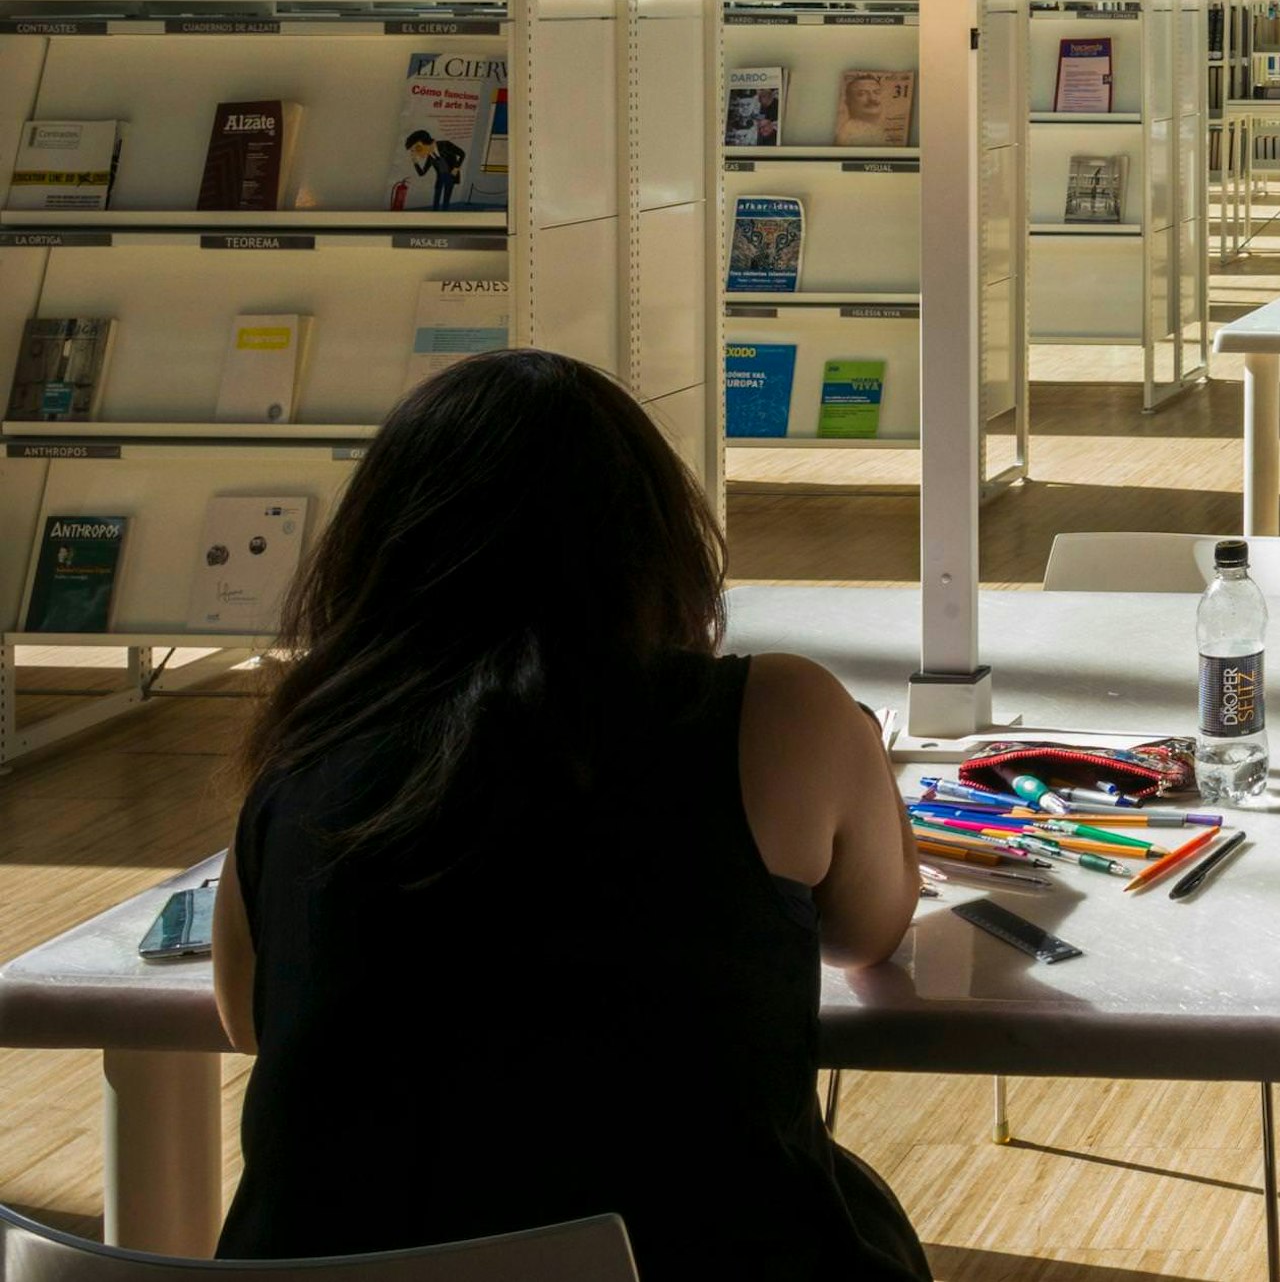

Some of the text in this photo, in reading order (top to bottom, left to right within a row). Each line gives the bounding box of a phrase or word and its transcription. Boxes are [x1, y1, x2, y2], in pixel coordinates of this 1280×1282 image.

[16, 23, 78, 34] CONTRASTES
[182, 22, 280, 33] CUADERNOS DE ALZATE
[401, 23, 458, 33] EL CIERVO
[416, 58, 440, 77] EL
[730, 73, 768, 82] DARDO
[411, 84, 442, 98] Cómo
[432, 99, 442, 109] el
[444, 101, 462, 110] arte
[223, 114, 276, 131] Alzate
[864, 164, 893, 172] VISUAL
[15, 236, 63, 245] LA ORTIGA
[225, 237, 280, 248] TEOREMA
[409, 237, 449, 248] PASAJES
[440, 281, 510, 292] PASAJES
[24, 447, 88, 458] ANTHROPOS
[50, 521, 121, 538] ANTHROPOS
[1222, 666, 1238, 726] DROPER
[1237, 670, 1255, 722] SELTZ
